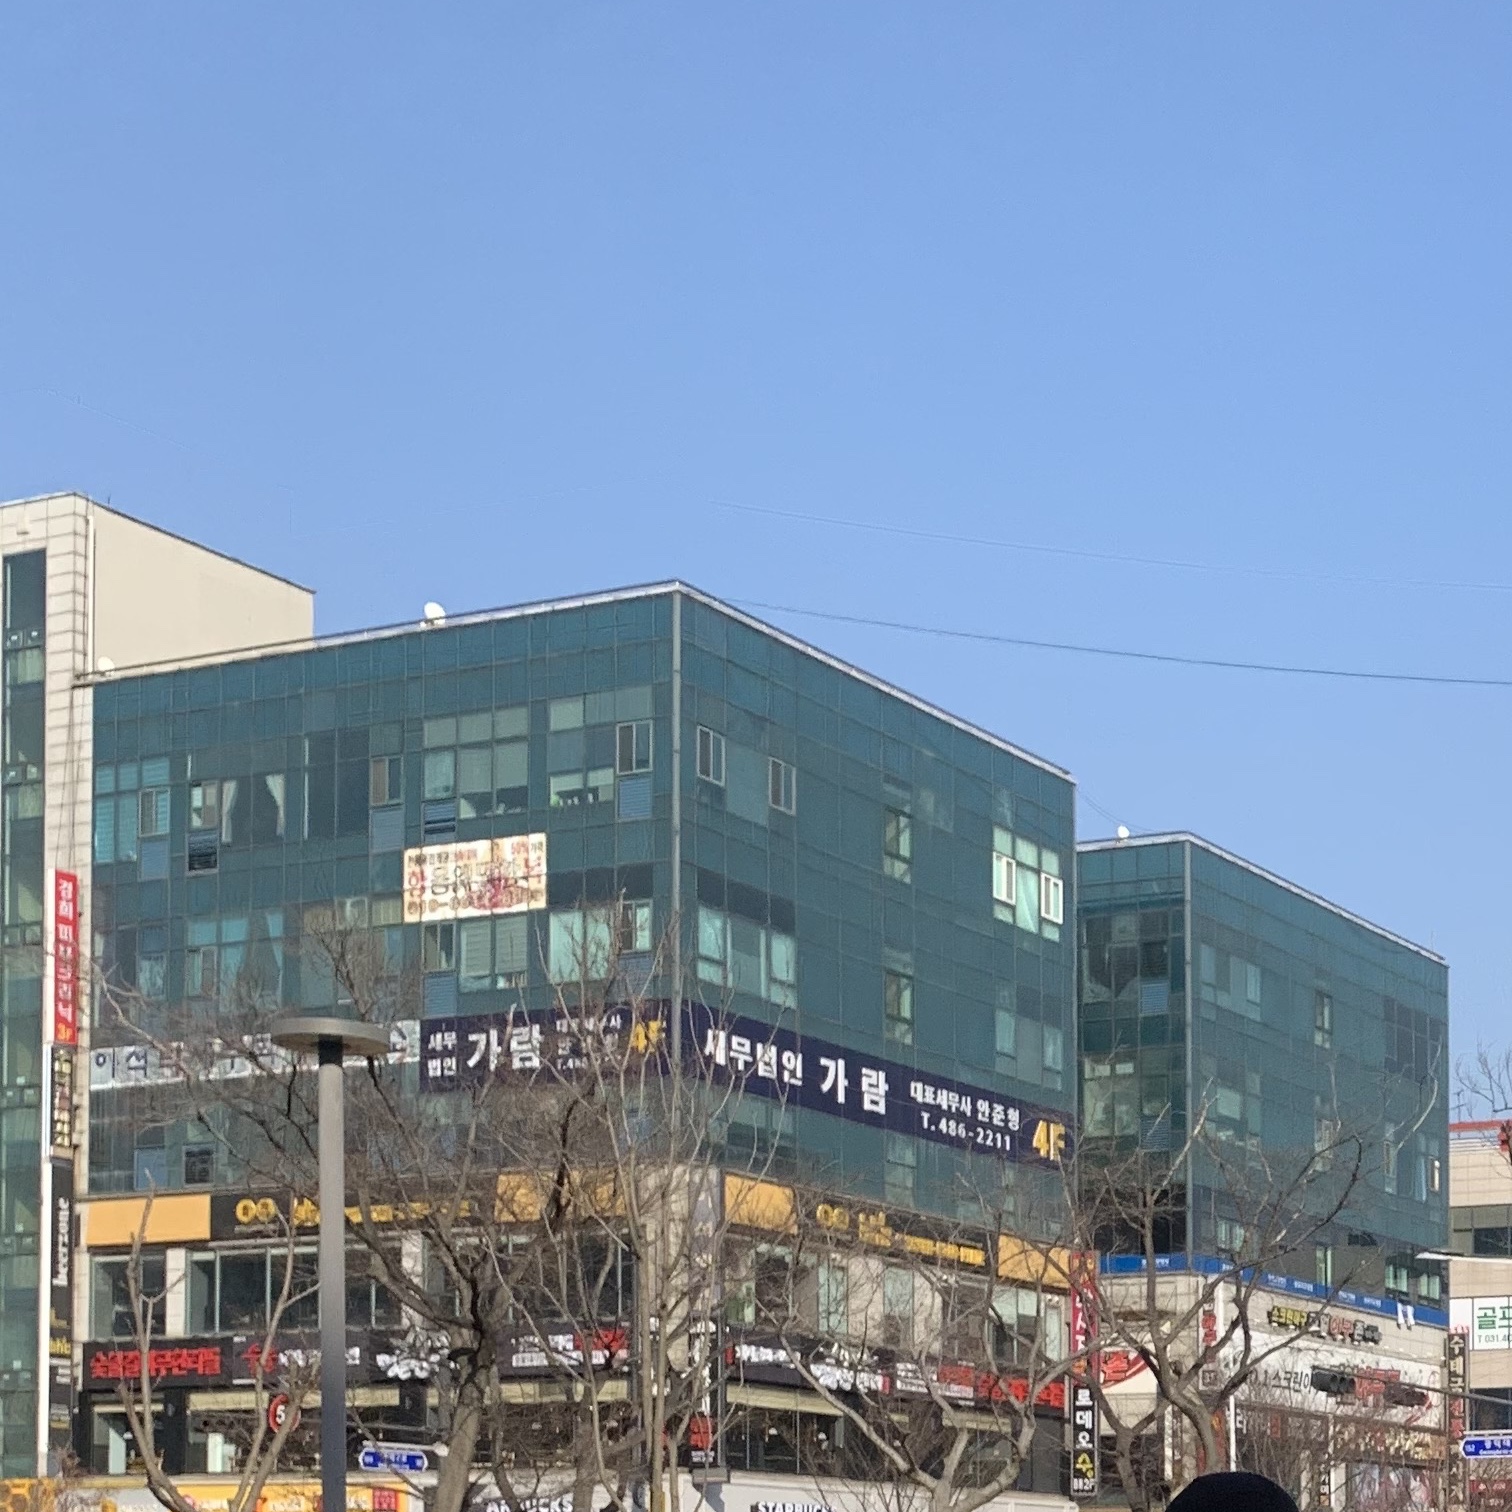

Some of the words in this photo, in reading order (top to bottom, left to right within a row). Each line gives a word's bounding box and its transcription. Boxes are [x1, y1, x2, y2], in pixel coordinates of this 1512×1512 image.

[428, 1031, 458, 1052] 세무
[466, 1024, 545, 1073] 가람
[427, 1058, 458, 1078] 법인
[704, 1028, 804, 1087] 세무법인
[819, 1057, 889, 1116] 가람
[909, 1079, 973, 1115] 대표세무사
[976, 1100, 1021, 1131] 안준형
[920, 1112, 1012, 1151] T.486-2211
[1032, 1118, 1066, 1158] 4F
